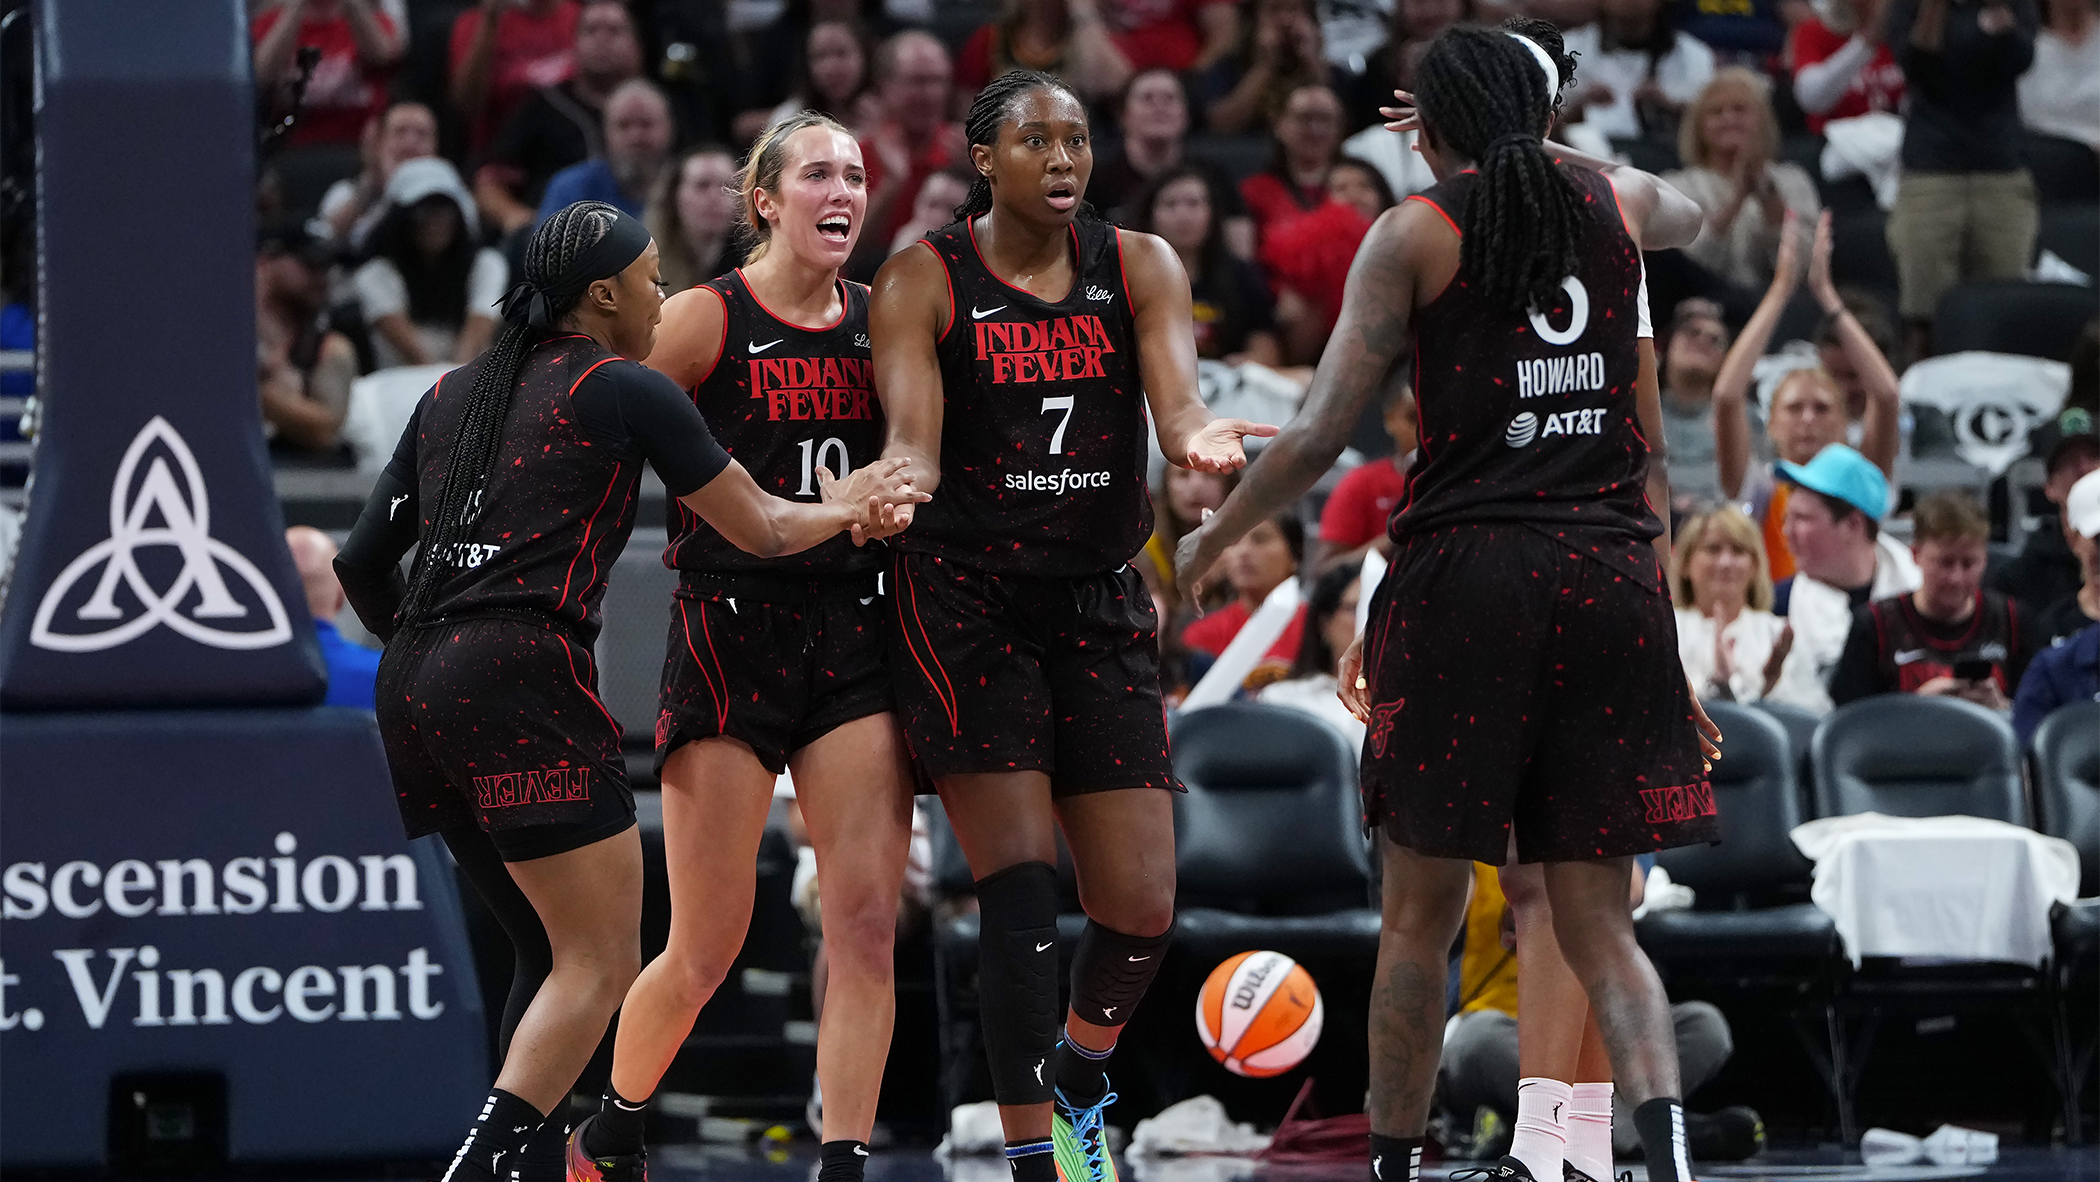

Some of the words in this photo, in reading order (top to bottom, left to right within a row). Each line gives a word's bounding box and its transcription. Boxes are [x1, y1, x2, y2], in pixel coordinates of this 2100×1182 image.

[1085, 285, 1115, 304] Lilly
[854, 333, 871, 349] Lil
[973, 314, 1116, 361] INDIANA
[990, 346, 1107, 384] FEVER
[1516, 352, 1606, 399] HOWARD
[765, 388, 874, 421] FEVER
[1040, 394, 1075, 454] 7
[1541, 407, 1608, 439] AT&T
[795, 437, 850, 496] 10
[1005, 468, 1111, 495] salesforce
[472, 767, 590, 809] FEVER
[1638, 781, 1718, 824] EVER
[0, 831, 424, 920] scension
[0, 954, 45, 1032] t.
[52, 944, 445, 1031] Vincent
